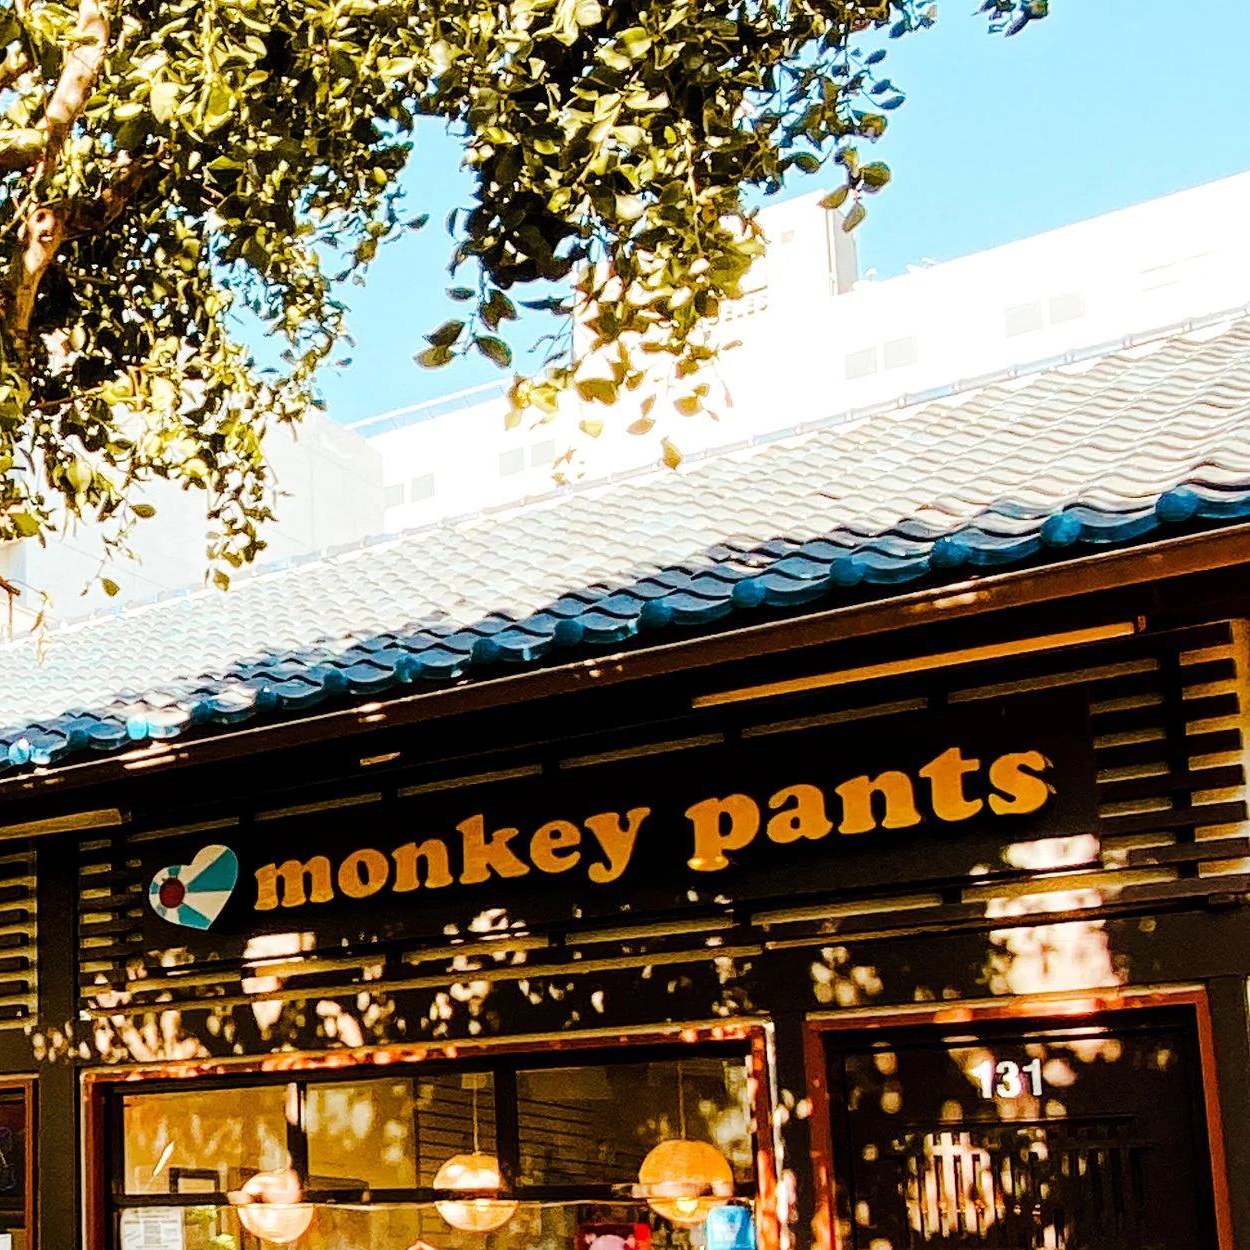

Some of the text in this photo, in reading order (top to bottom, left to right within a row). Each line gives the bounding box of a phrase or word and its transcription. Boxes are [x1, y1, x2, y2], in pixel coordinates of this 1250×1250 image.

[252, 747, 1057, 912] monkey pants
[972, 1058, 1043, 1099] 131
